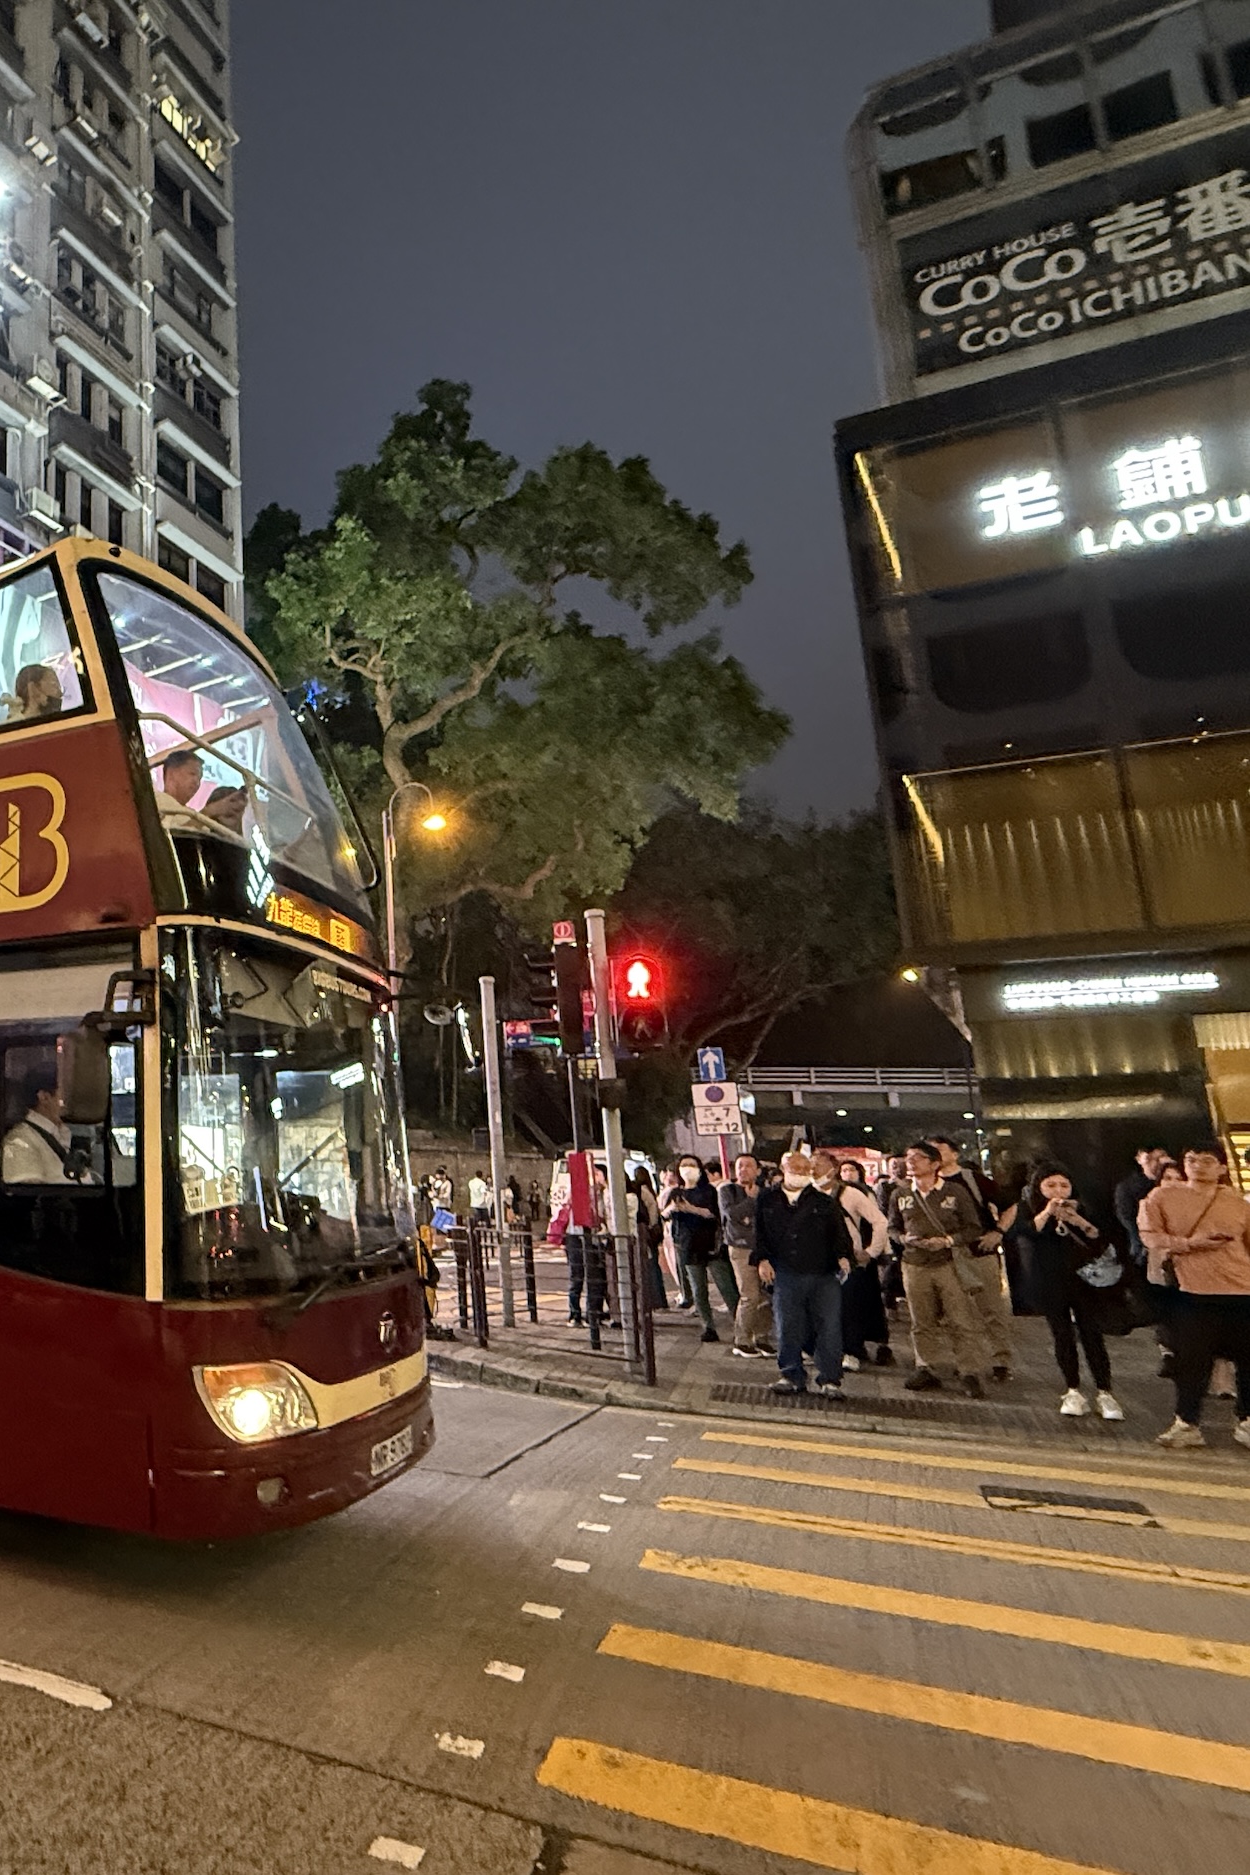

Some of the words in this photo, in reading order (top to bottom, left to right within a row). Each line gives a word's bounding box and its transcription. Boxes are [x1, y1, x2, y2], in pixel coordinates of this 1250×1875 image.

[914, 249, 988, 283] CURRY
[992, 221, 1077, 259] HOUSE
[1078, 494, 1250, 556] LAOPU
[725, 1122, 739, 1132] 12
[898, 1196, 914, 1211] 02
